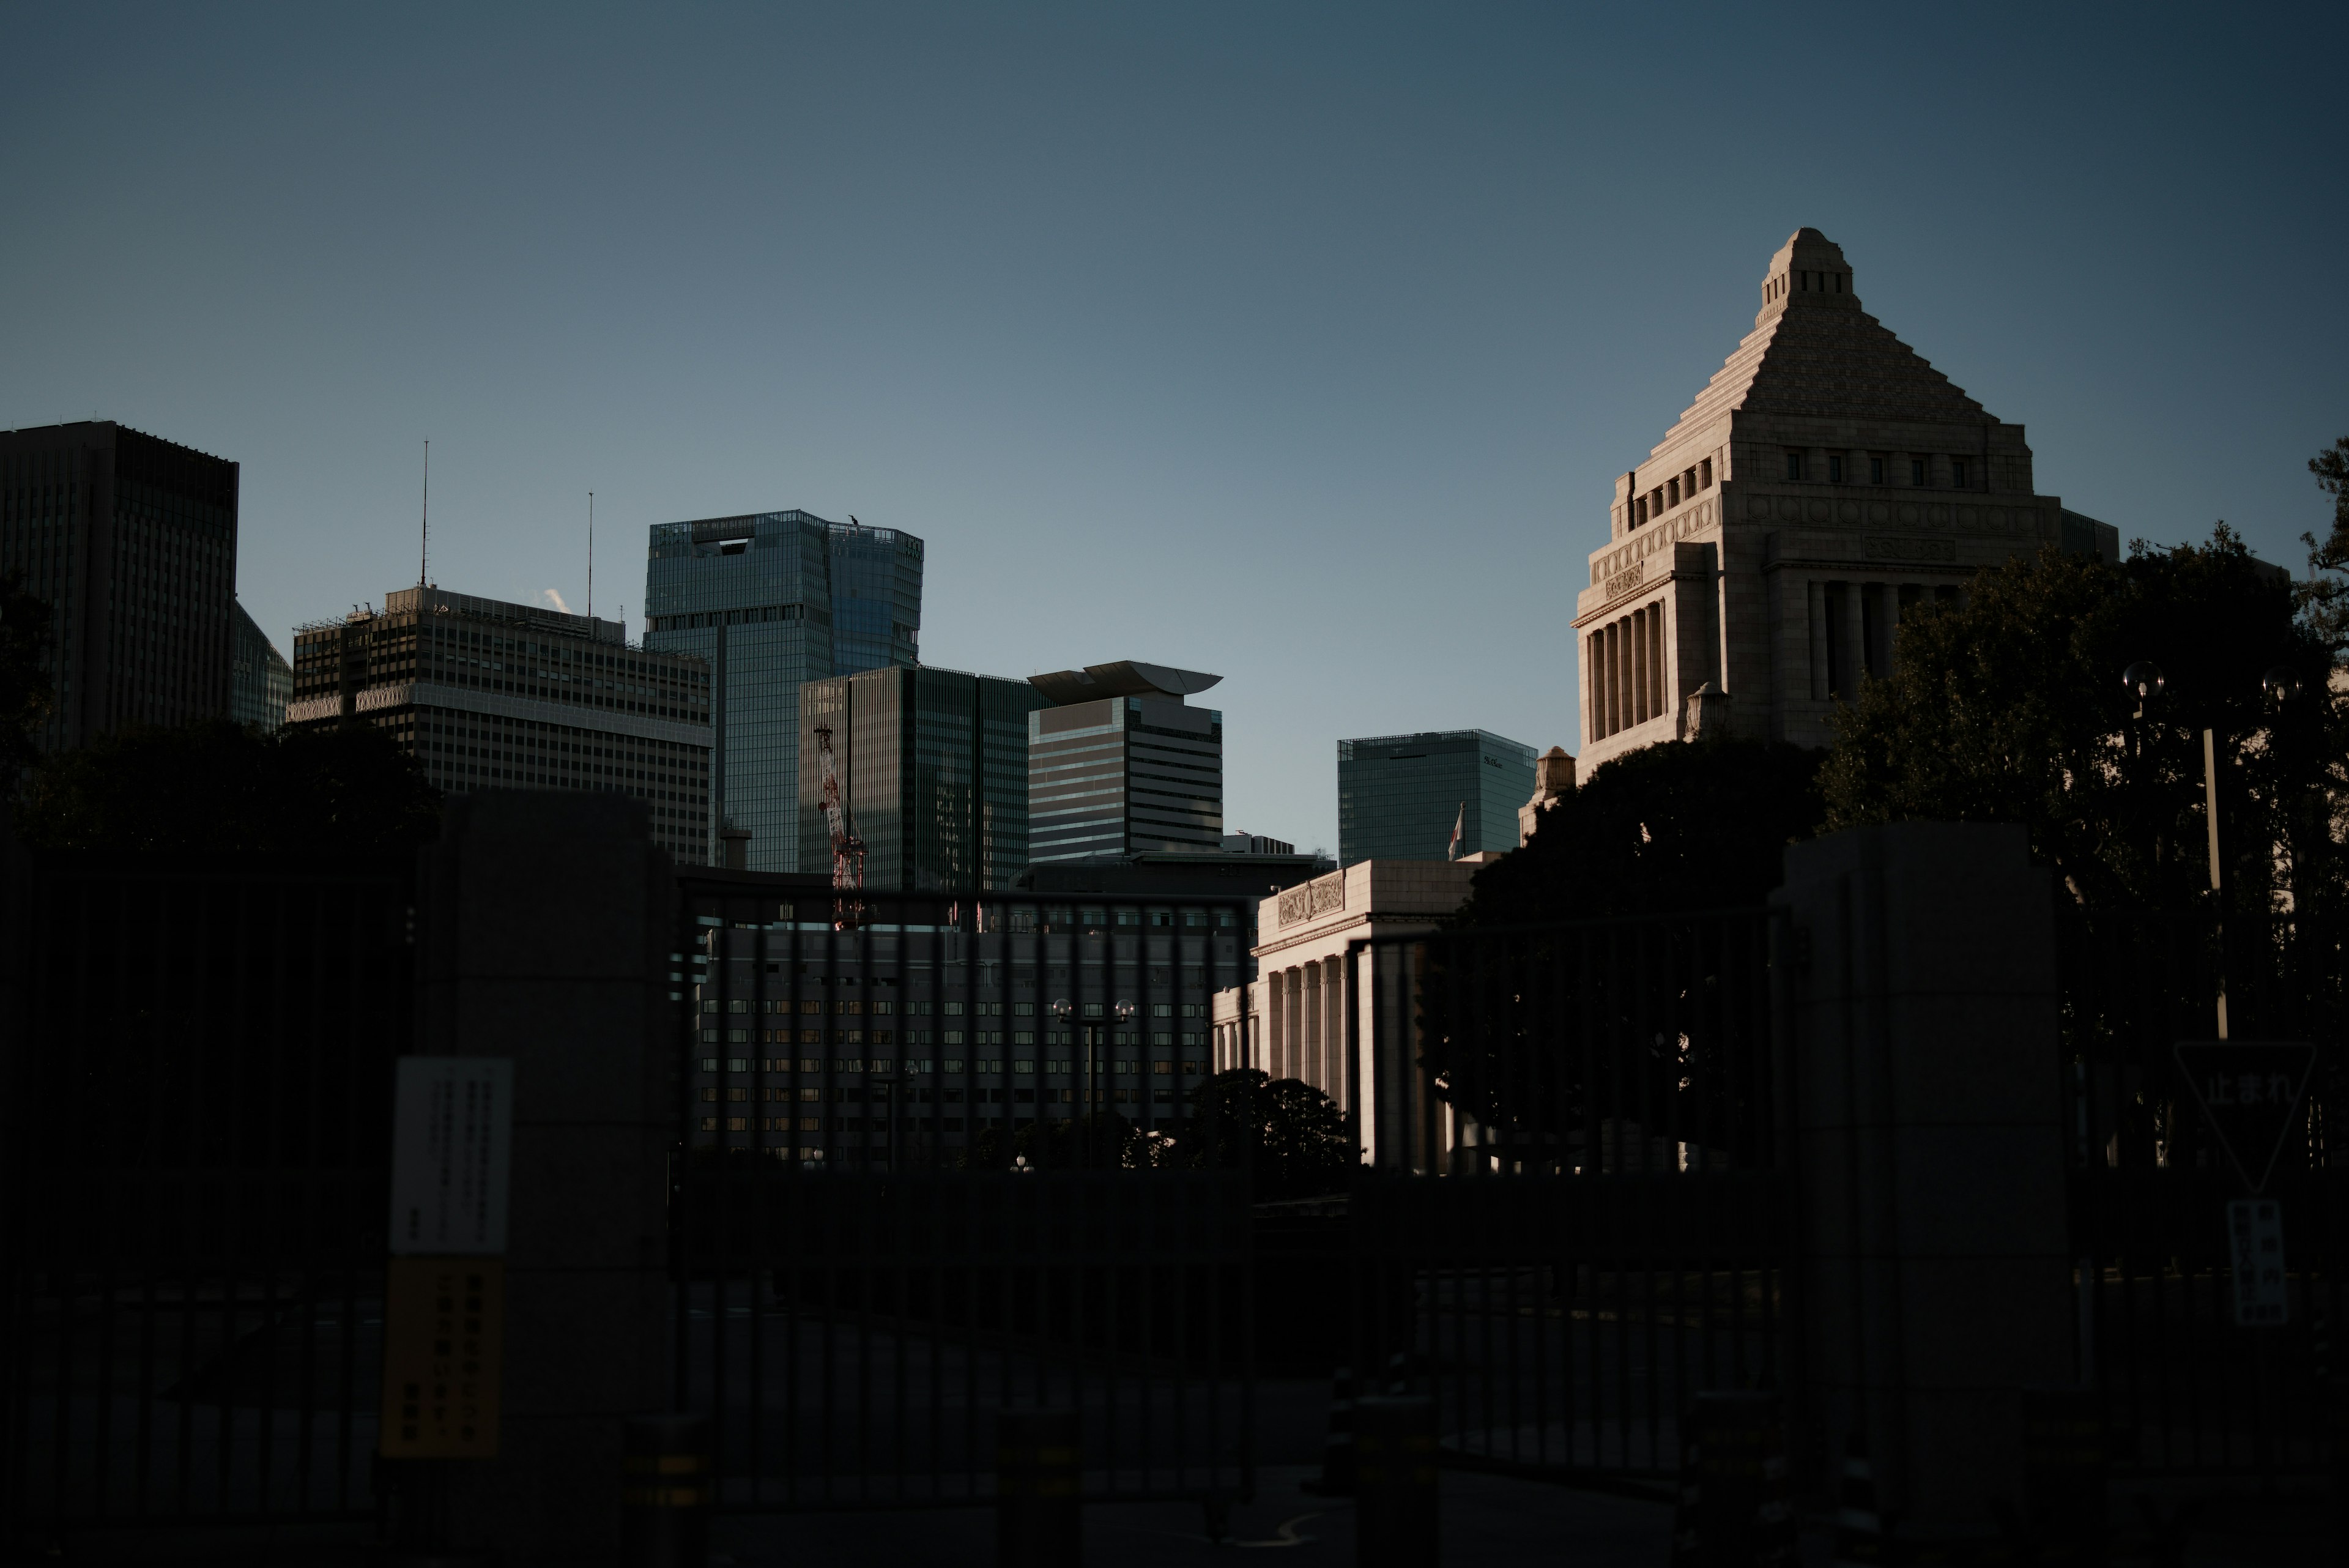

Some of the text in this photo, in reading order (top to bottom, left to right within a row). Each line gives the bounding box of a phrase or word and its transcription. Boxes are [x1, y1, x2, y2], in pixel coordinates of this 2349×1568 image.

[2207, 1071, 2296, 1104] 止まれ
[2234, 1205, 2255, 1302] 無断立入禁止
[2259, 1205, 2280, 1285] 敷地内
